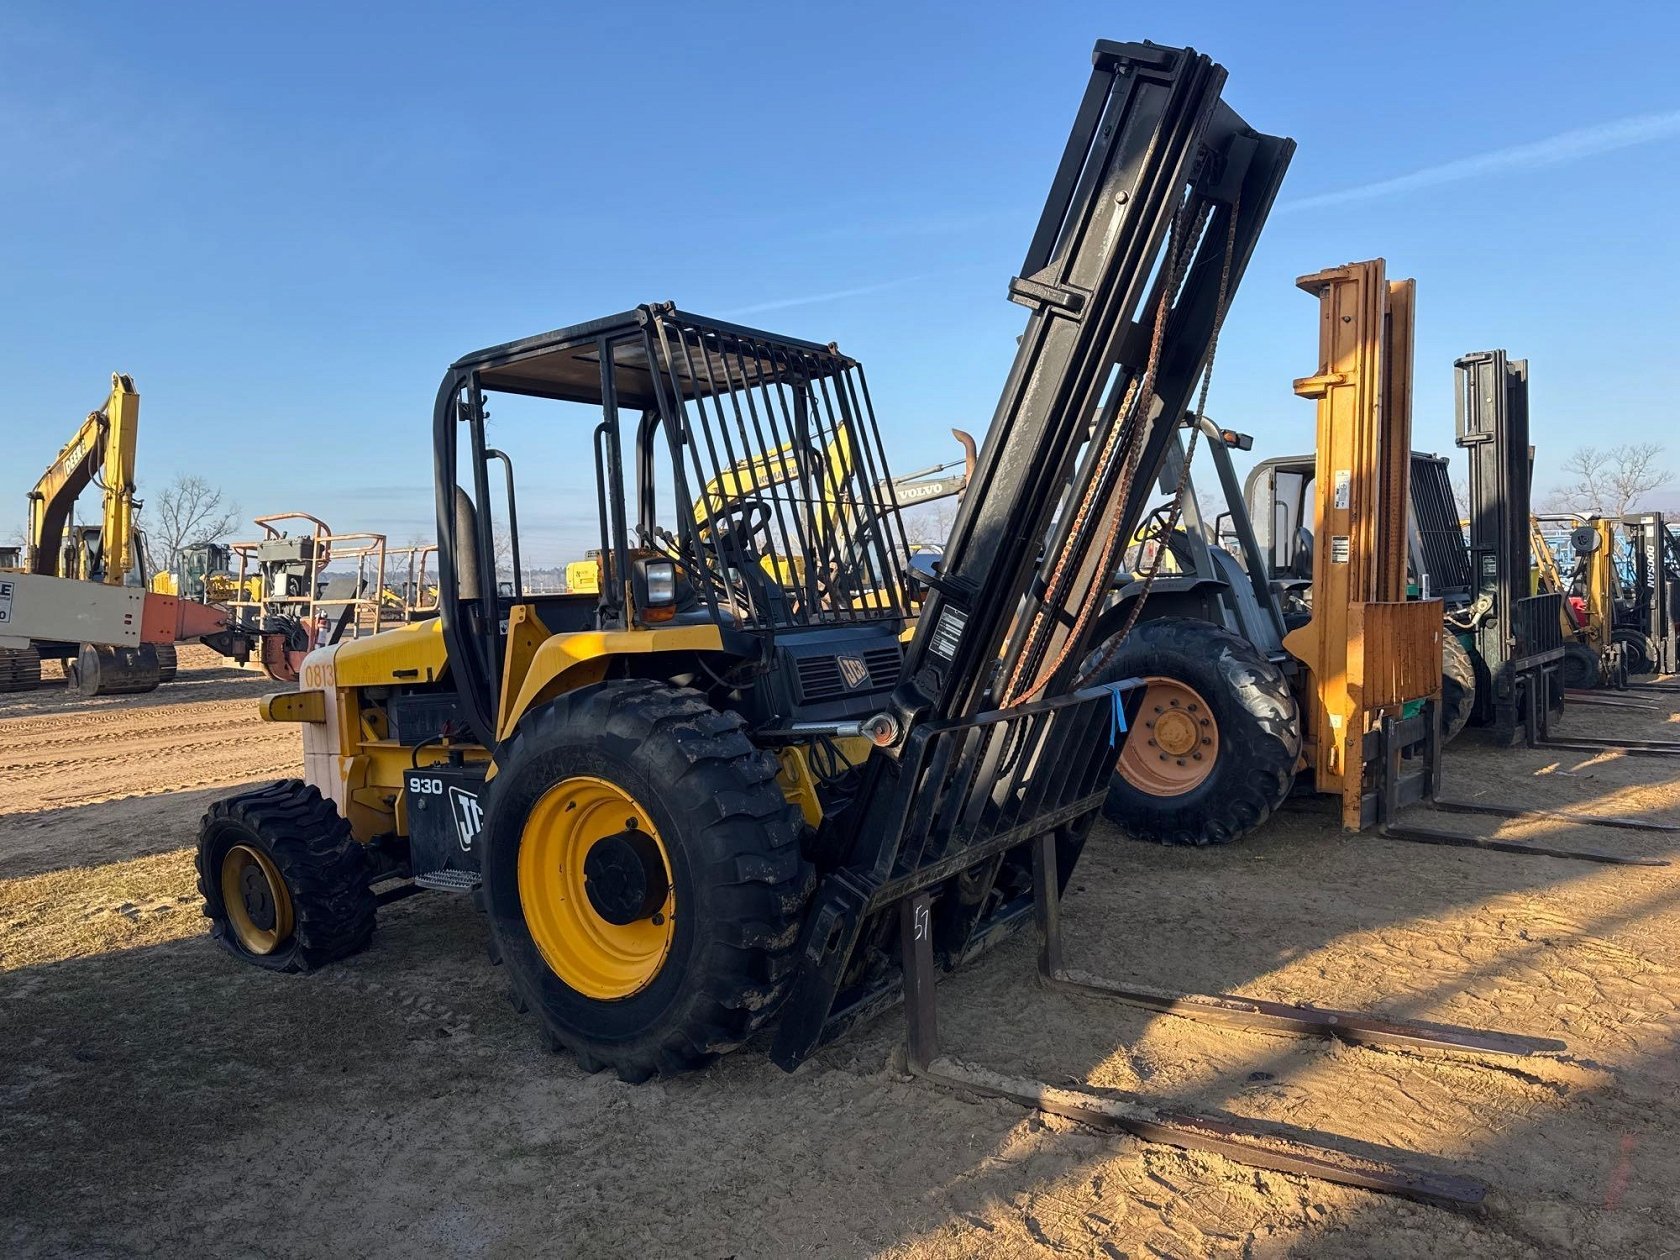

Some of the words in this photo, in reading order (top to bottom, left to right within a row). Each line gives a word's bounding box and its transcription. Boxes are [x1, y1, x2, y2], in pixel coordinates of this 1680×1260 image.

[898, 483, 943, 499] VOLVO
[1646, 544, 1656, 589] DOOSAN
[840, 658, 867, 686] JCB
[410, 777, 443, 795] 930
[457, 793, 485, 844] JC
